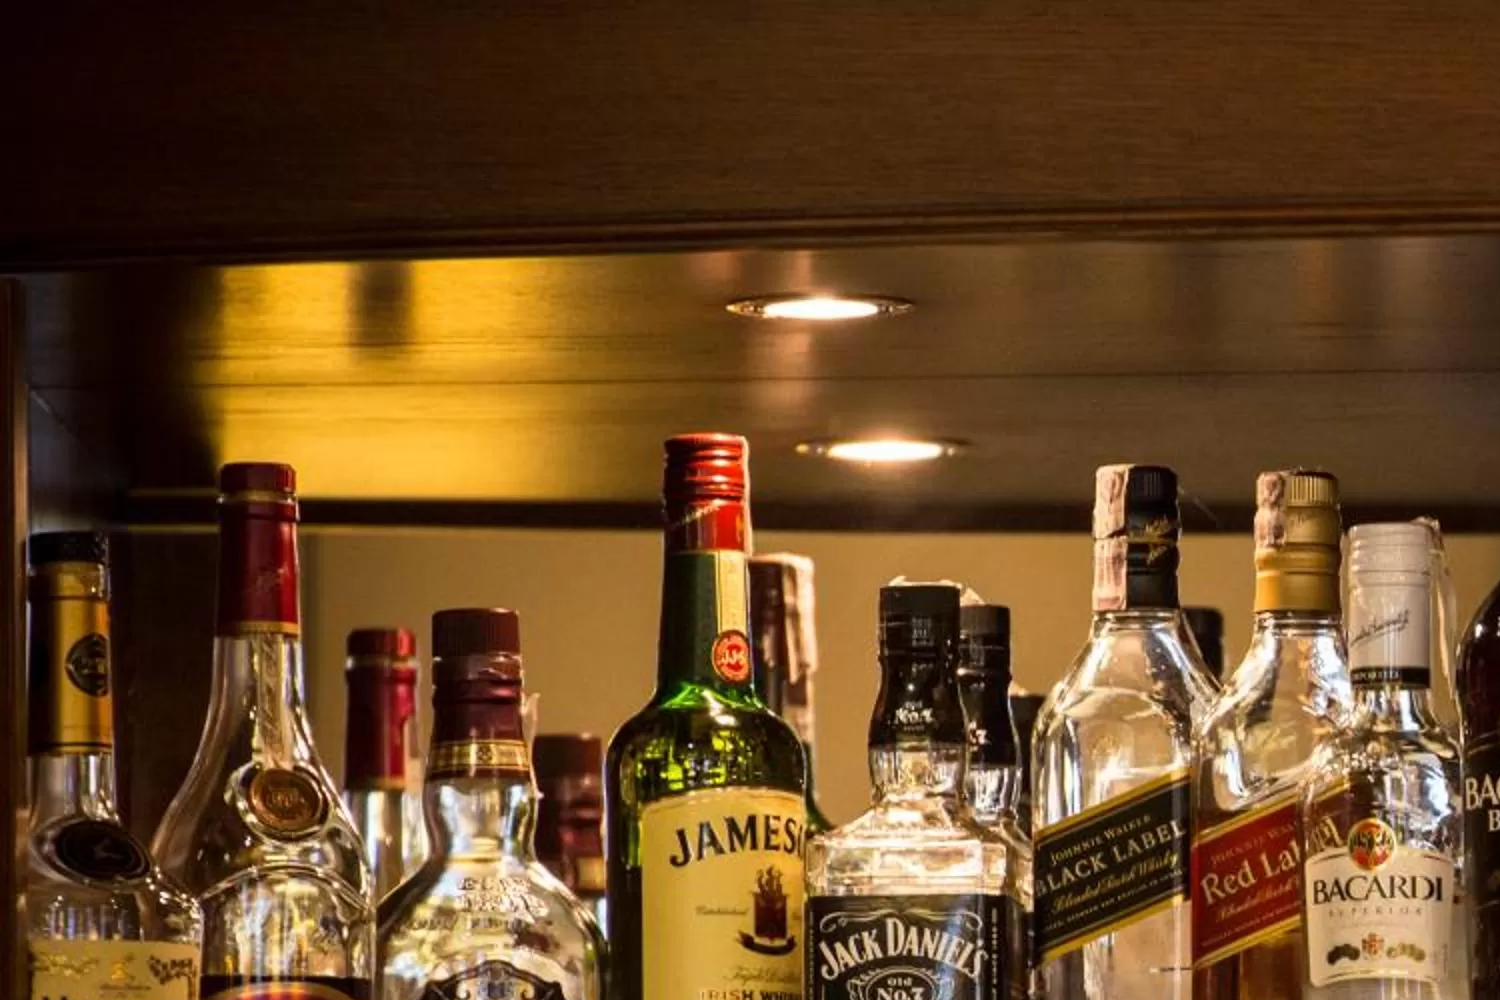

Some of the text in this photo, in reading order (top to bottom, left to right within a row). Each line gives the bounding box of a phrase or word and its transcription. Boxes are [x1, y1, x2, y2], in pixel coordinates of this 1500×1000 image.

[669, 813, 804, 868] JAMES
[1035, 852, 1108, 898] BLACK
[1112, 818, 1187, 863] LABEL
[1200, 862, 1257, 906] Red
[1313, 874, 1443, 905] BACARDI
[819, 917, 989, 981] JACK DANIEL'S
[887, 977, 913, 986] Old
